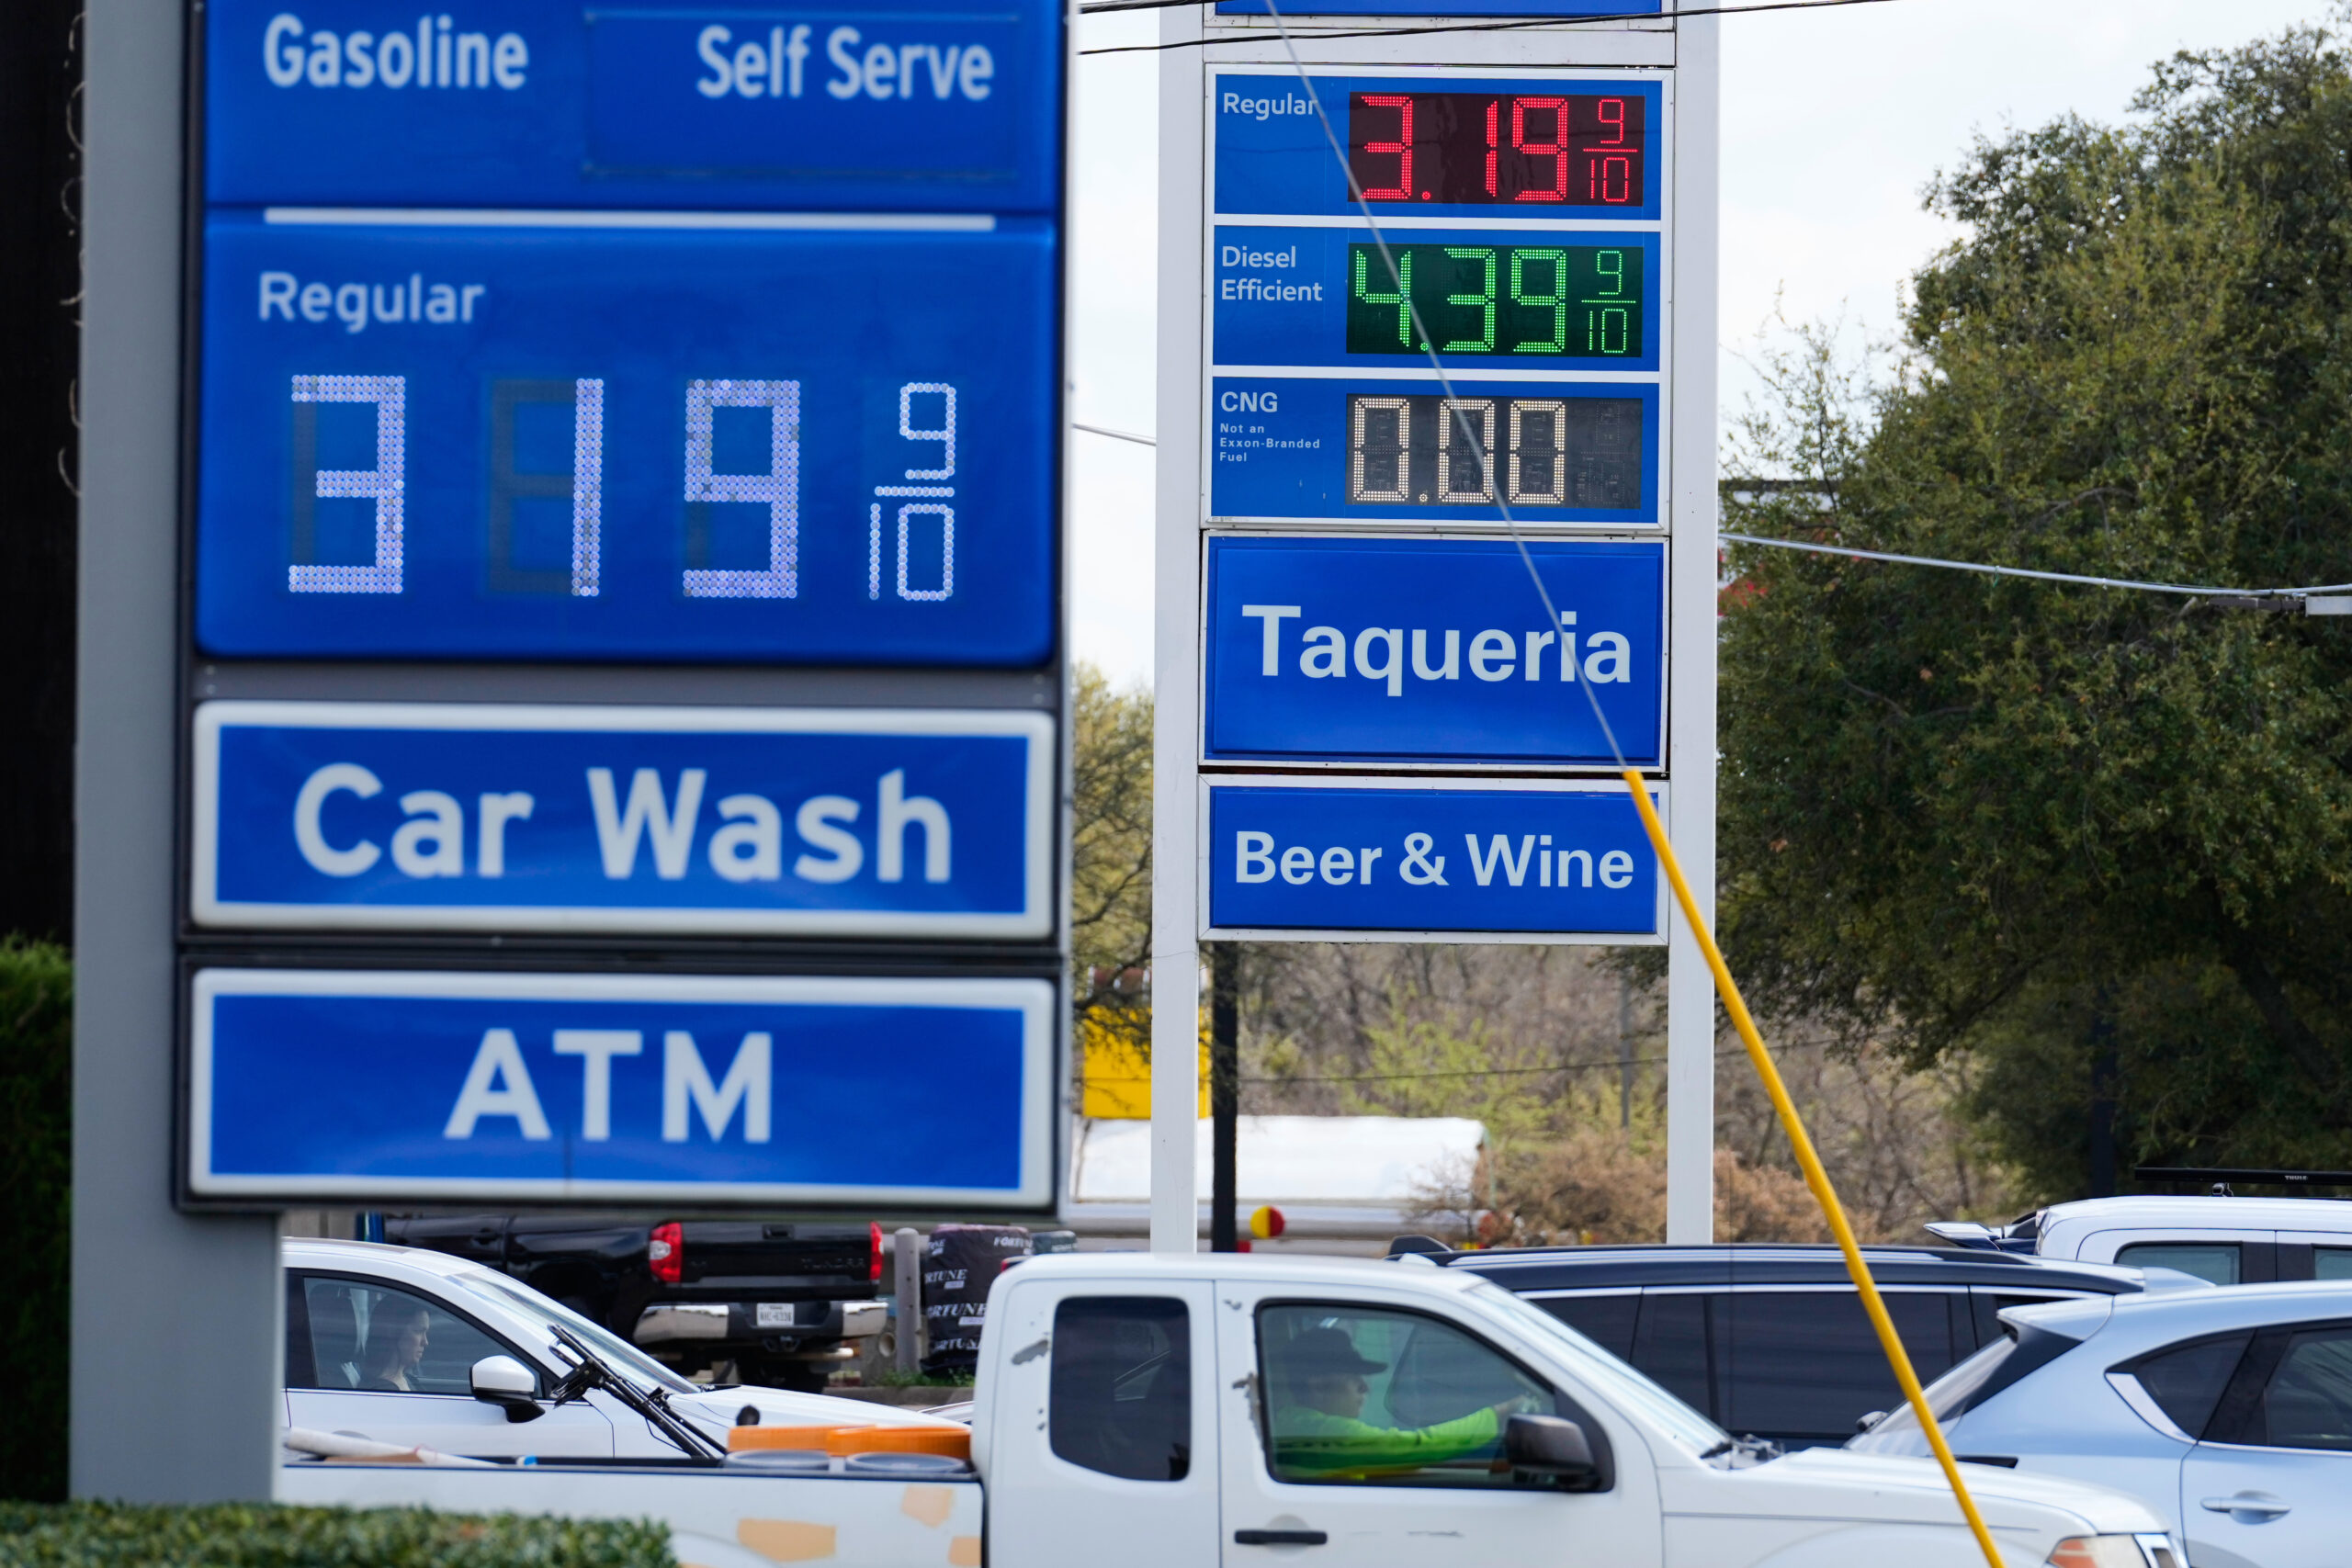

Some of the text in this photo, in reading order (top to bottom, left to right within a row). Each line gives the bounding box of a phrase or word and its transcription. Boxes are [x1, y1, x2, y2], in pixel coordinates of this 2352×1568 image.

[263, 14, 529, 90] Gasoline
[696, 25, 994, 100] Self Serve
[1223, 93, 1319, 121] Regular
[1221, 245, 1296, 268] Diesel
[258, 271, 485, 333] Regular
[1221, 277, 1323, 302] Efficient
[1220, 391, 1278, 412] CNG
[1220, 423, 1265, 434] Not an
[1219, 437, 1320, 449] Exxon-Branded
[1219, 451, 1248, 462] Fuel
[1241, 604, 1631, 697] Taqueria
[294, 763, 951, 883] Car Wash
[1236, 830, 1634, 889] Beer & Wine
[443, 1028, 772, 1143] ATM
[924, 1269, 967, 1284] RTUNE
